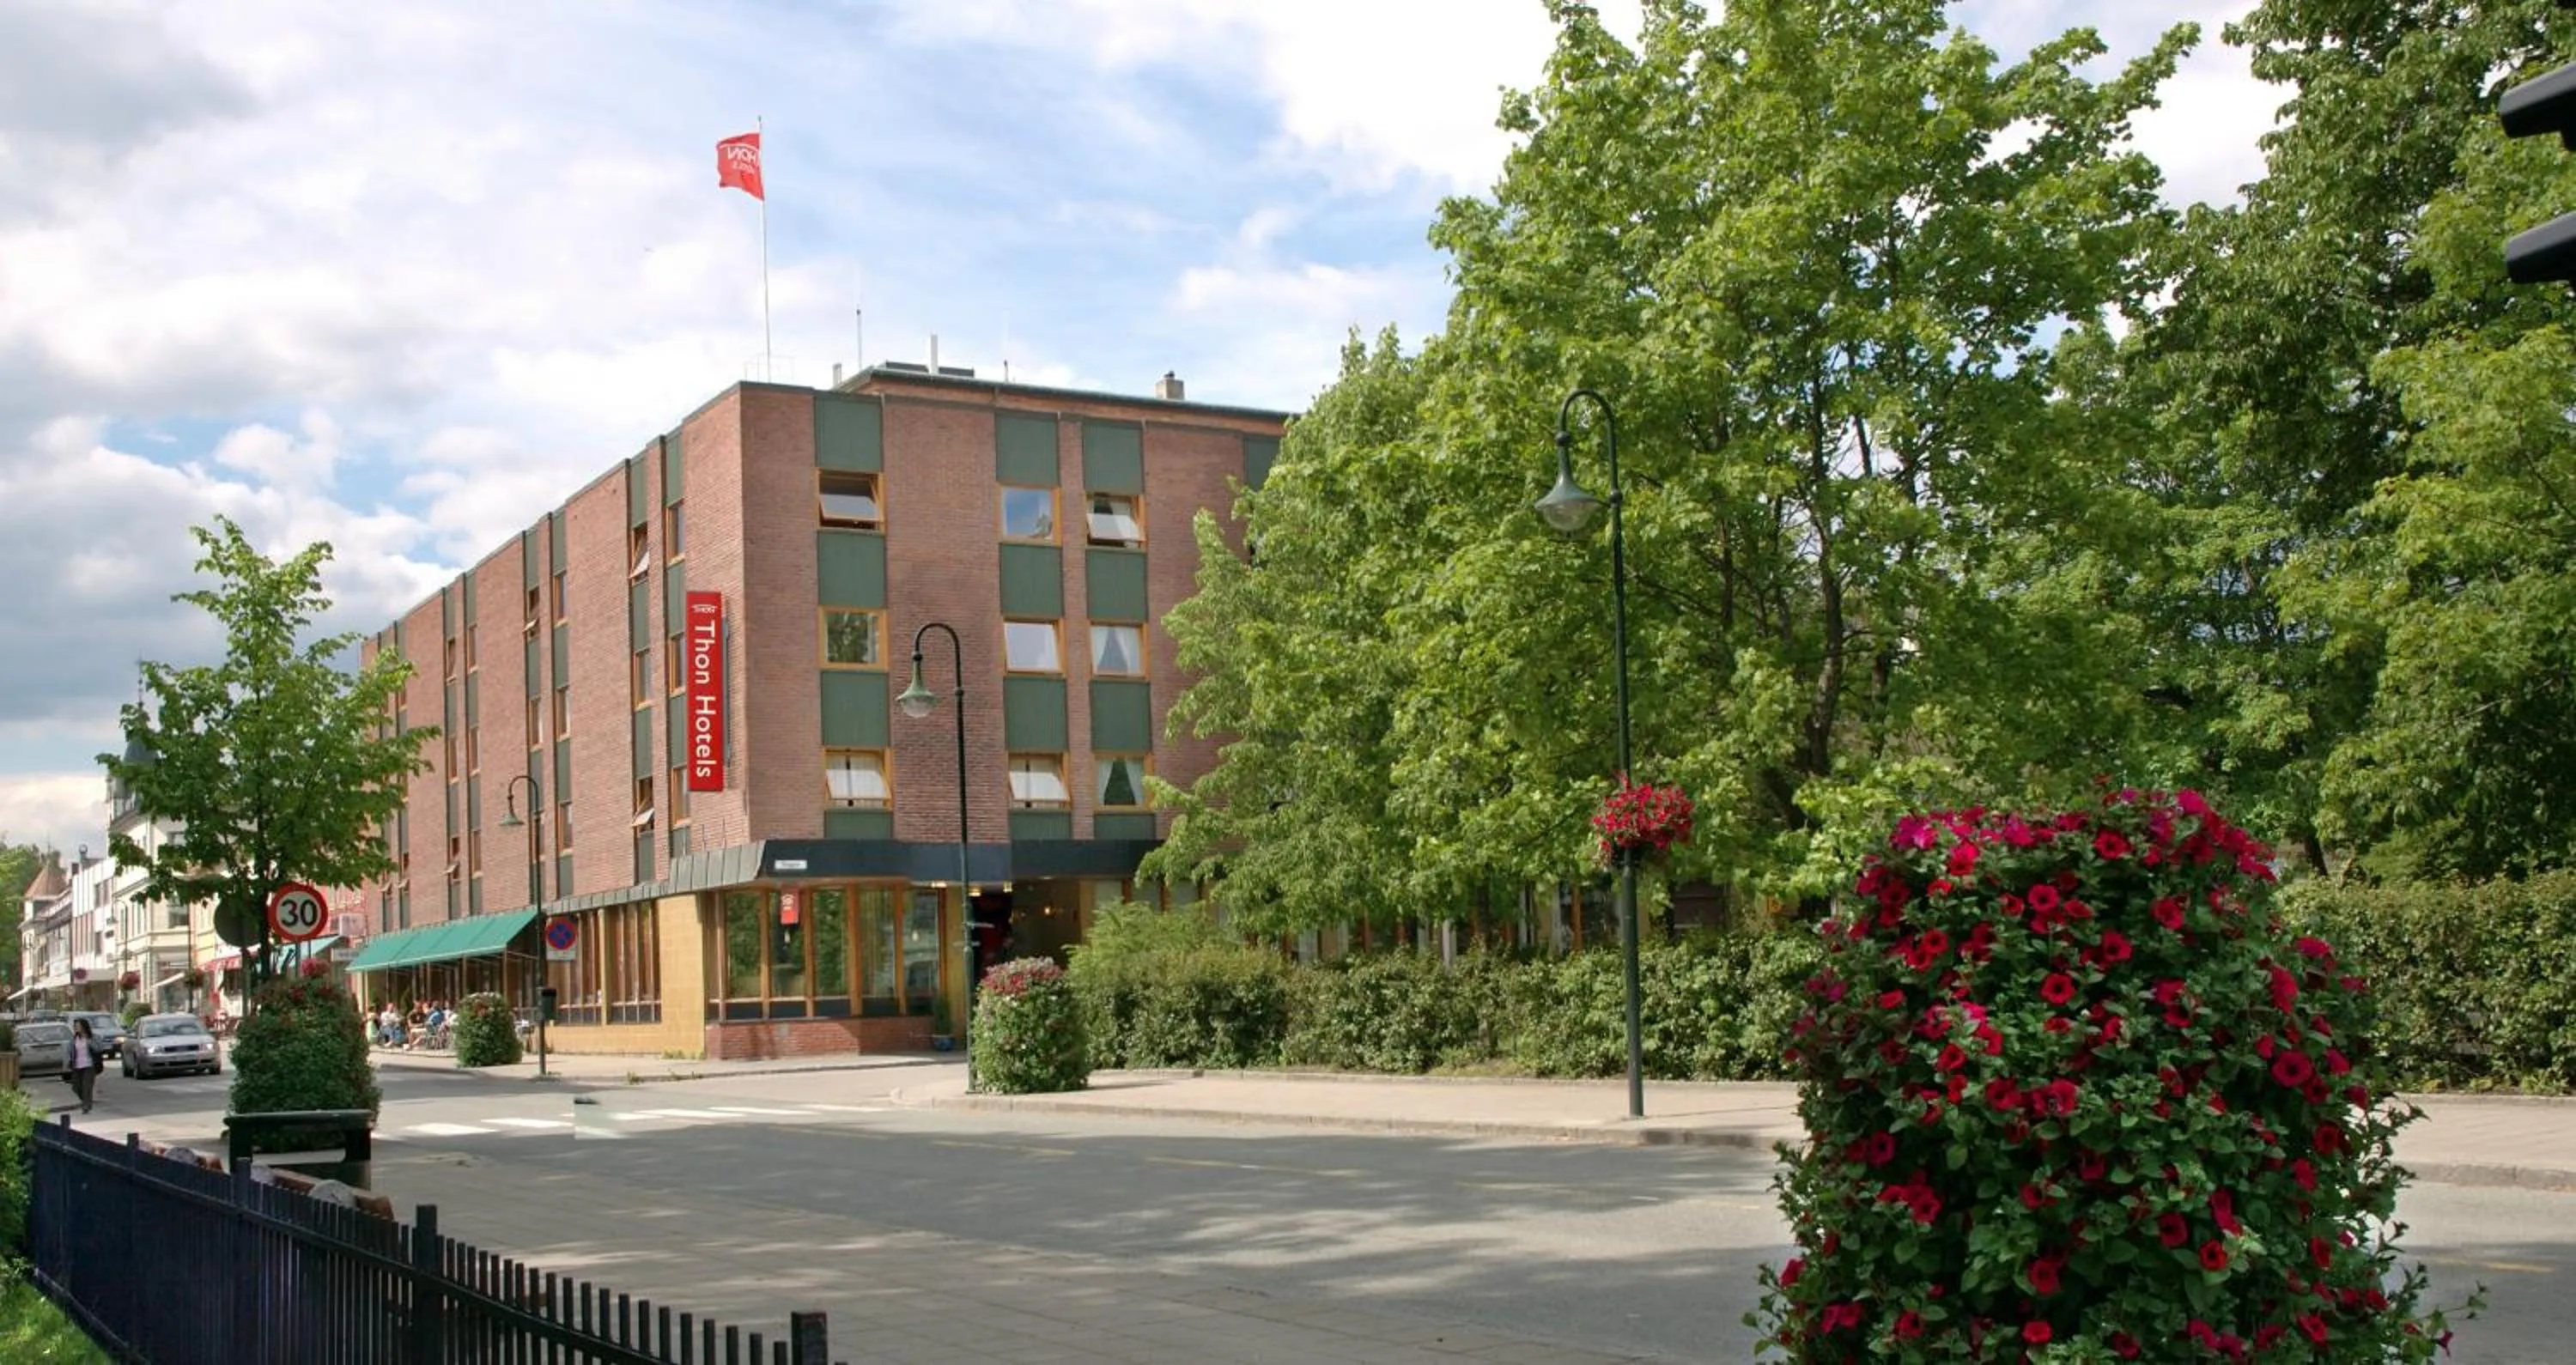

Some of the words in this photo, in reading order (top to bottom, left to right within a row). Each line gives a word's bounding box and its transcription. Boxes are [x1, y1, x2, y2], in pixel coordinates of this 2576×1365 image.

[695, 620, 715, 684] Thon
[696, 695, 717, 777] Hotels
[281, 899, 318, 927] 30
